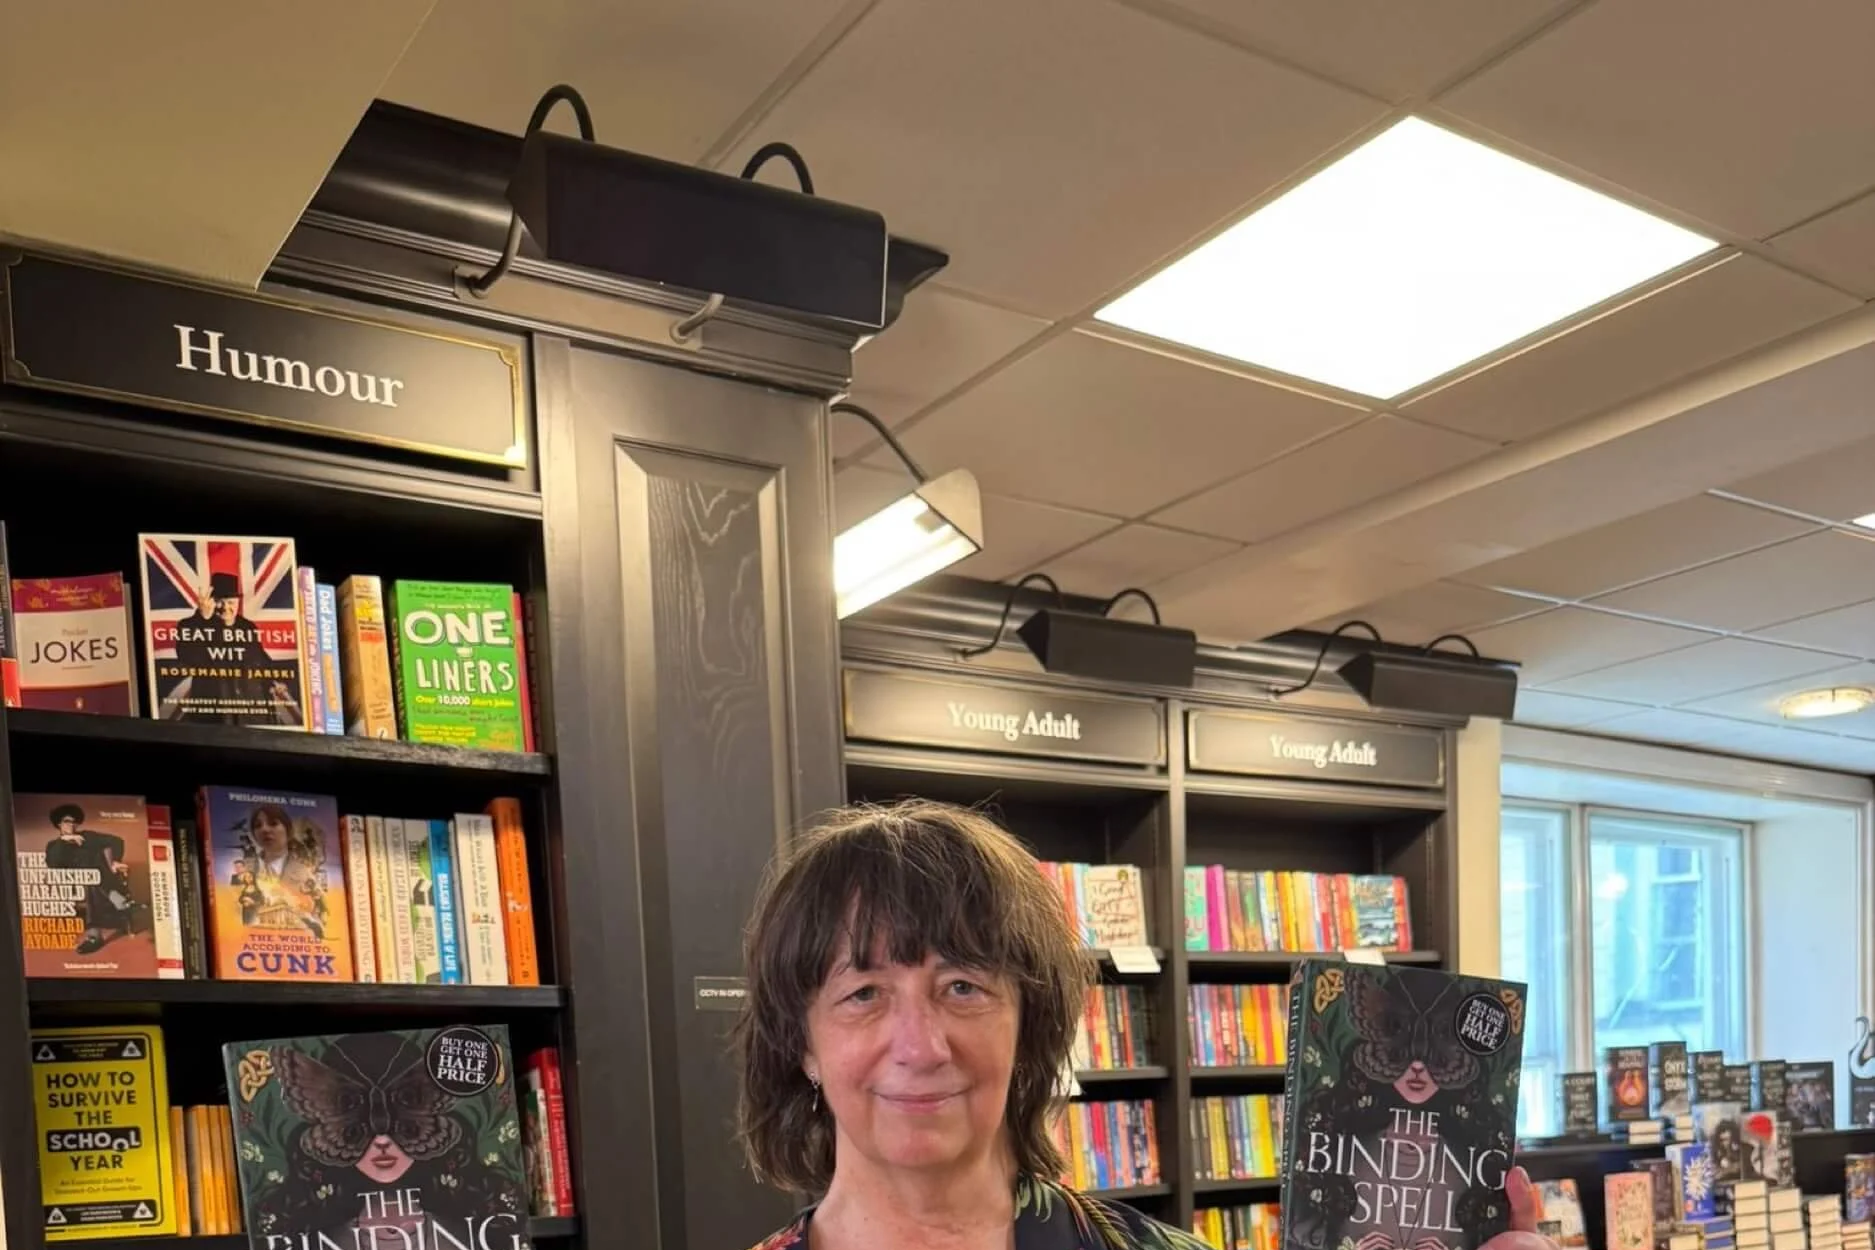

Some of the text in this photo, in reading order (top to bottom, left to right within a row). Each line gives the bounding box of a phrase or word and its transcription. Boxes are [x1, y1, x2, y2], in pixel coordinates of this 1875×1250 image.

[173, 323, 404, 408] Humour
[154, 628, 296, 644] GREAT BRITISH
[404, 610, 512, 646] ONE
[30, 637, 118, 663] JOKES
[207, 647, 245, 661] WIT
[160, 667, 295, 679] ROSEMARIE JARSKI
[415, 657, 515, 695] LINERS
[947, 702, 1081, 740] Young Adult
[1269, 735, 1377, 767] Young Adult
[228, 792, 317, 808] PHILOMENA CUNK
[19, 852, 47, 869] THE
[19, 868, 101, 886] UNFINISHED
[20, 884, 86, 901] HARAULD
[22, 900, 77, 917] HUGHES
[23, 917, 85, 934] RICHARD
[25, 932, 78, 950] AYOADE
[250, 934, 322, 943] THE WORLD
[243, 943, 332, 954] ACCORDING TO
[236, 952, 337, 975] CUNK
[1470, 1006, 1504, 1027] GET ONE
[1472, 1000, 1505, 1020] BUY ONE
[1465, 1013, 1501, 1037] HALF
[442, 1037, 488, 1050] BUY ONE
[1461, 1023, 1498, 1050] PRICE
[440, 1045, 488, 1059] GET ONE
[439, 1054, 488, 1072] HALF
[46, 1071, 135, 1089] HOW TO
[437, 1067, 486, 1085] PRICE
[47, 1090, 137, 1109] SURVIVE
[74, 1110, 113, 1126] THE
[1388, 1107, 1441, 1138] THE
[50, 1131, 140, 1152] SCHOOL
[70, 1155, 124, 1171] YEAR
[1306, 1131, 1510, 1191] BINDING
[357, 1187, 424, 1219] THE
[1350, 1181, 1465, 1233] SPELL
